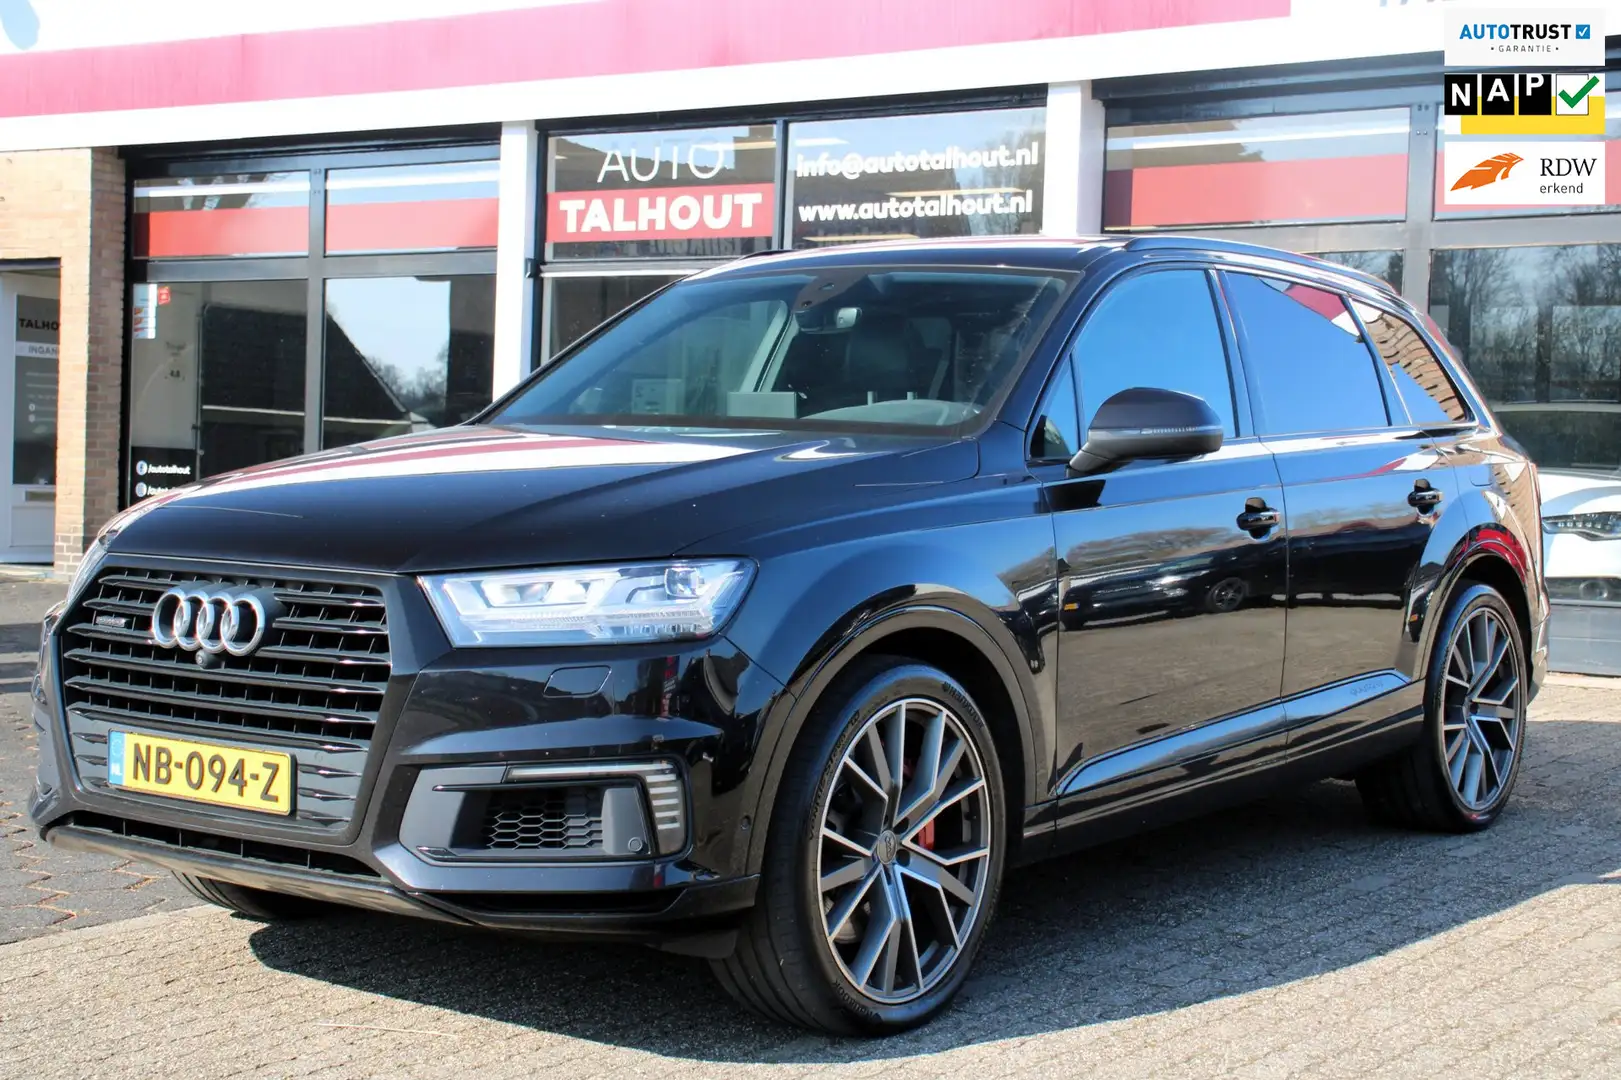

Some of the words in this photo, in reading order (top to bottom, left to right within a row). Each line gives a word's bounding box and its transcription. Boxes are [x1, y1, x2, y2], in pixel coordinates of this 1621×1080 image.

[796, 142, 1038, 180] info@autotalhout.nl
[559, 193, 762, 233] TALHOUT
[798, 190, 1033, 222] www.autotalhout.nl
[132, 743, 280, 803] NB-094-Z
